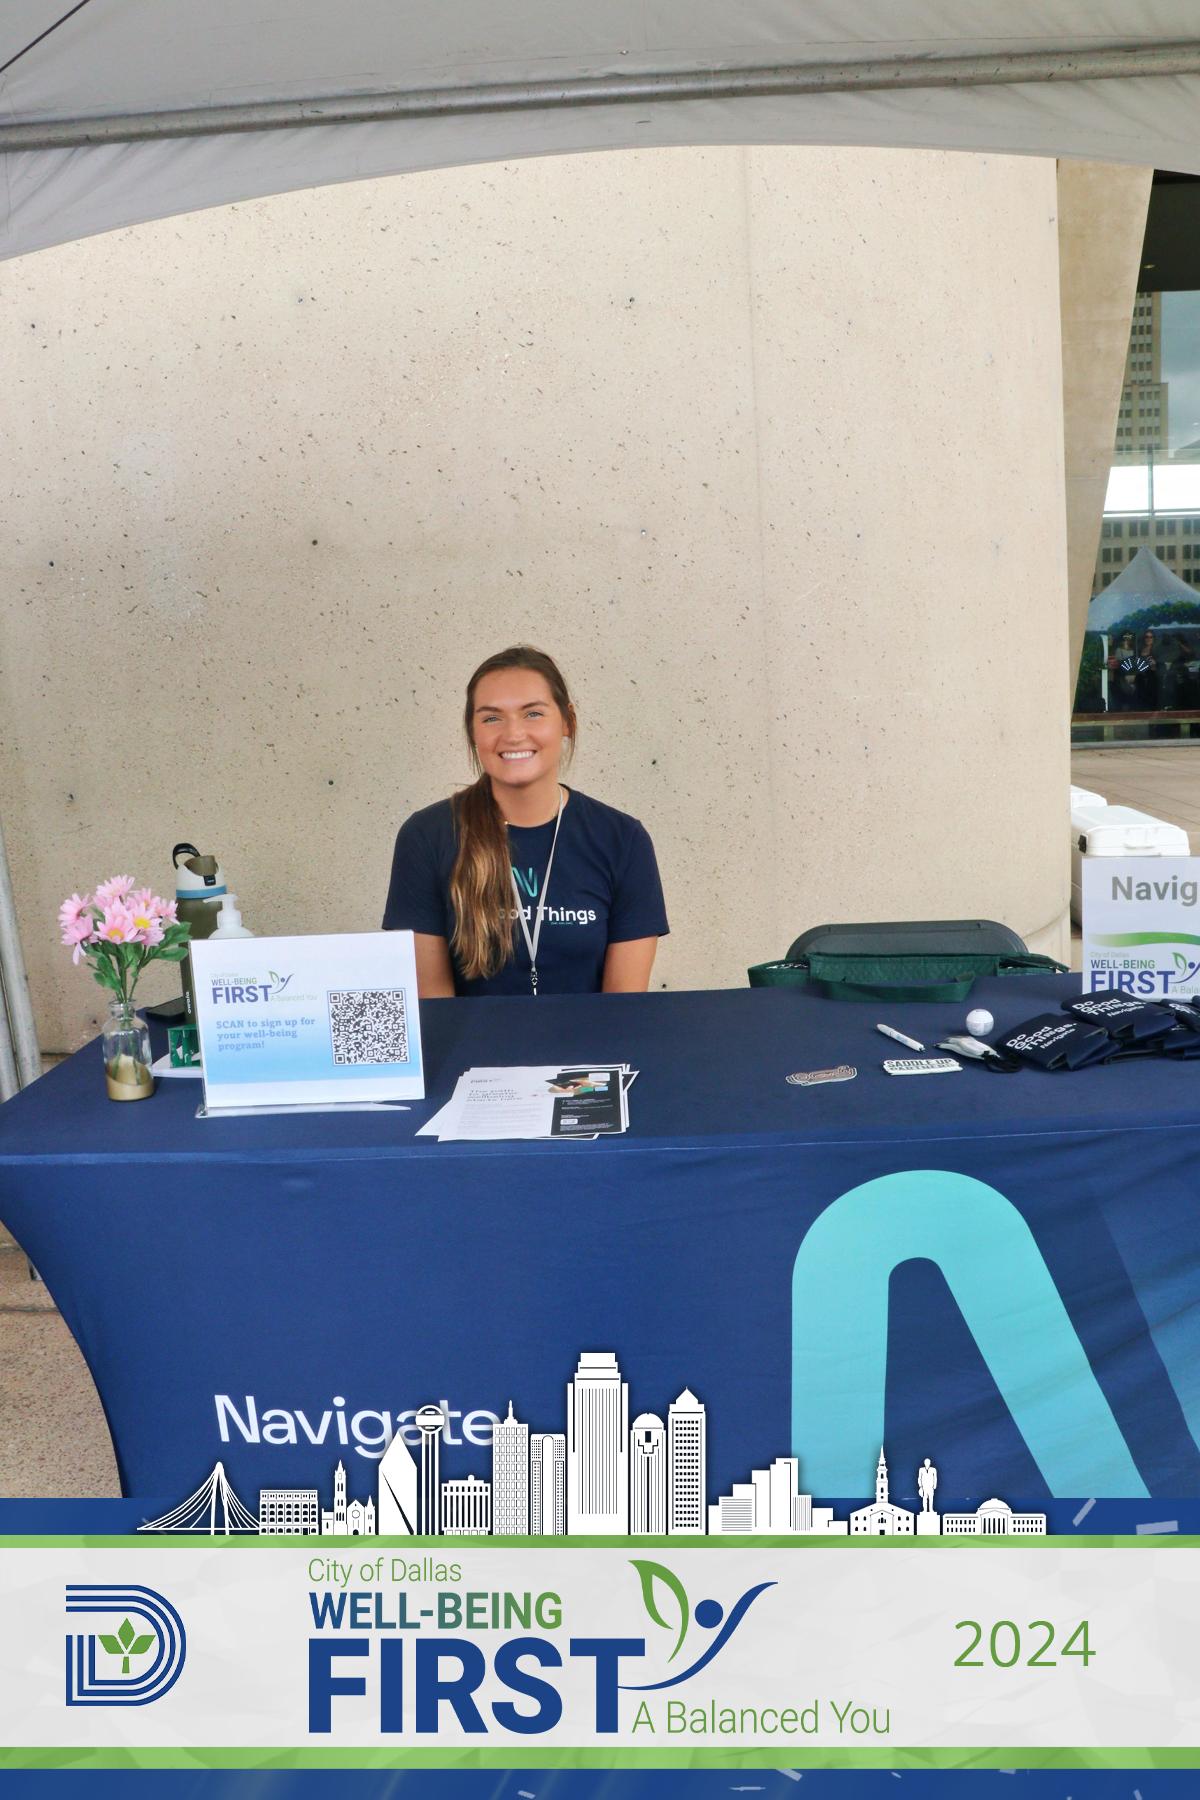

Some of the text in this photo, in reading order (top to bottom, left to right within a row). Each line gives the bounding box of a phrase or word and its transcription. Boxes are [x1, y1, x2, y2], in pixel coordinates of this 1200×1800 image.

[1111, 874, 1197, 906] Navig
[499, 906, 596, 925] ood Things
[1091, 960, 1155, 969] WELL-BEING
[211, 978, 257, 986] WELL-BEING
[1091, 971, 1175, 994] FIRST
[212, 985, 272, 1004] FIRST
[1072, 1001, 1094, 1010] Do
[1081, 998, 1121, 1013] Good
[216, 1017, 316, 1029] SCAN to sign up for
[217, 1029, 298, 1042] your well-being
[1006, 1034, 1027, 1047] Do
[1014, 1026, 1052, 1049] Good
[1021, 1023, 1077, 1051] Things.
[218, 1041, 265, 1052] program!
[887, 1059, 932, 1068] SADDLE
[214, 1395, 500, 1459] Navigate
